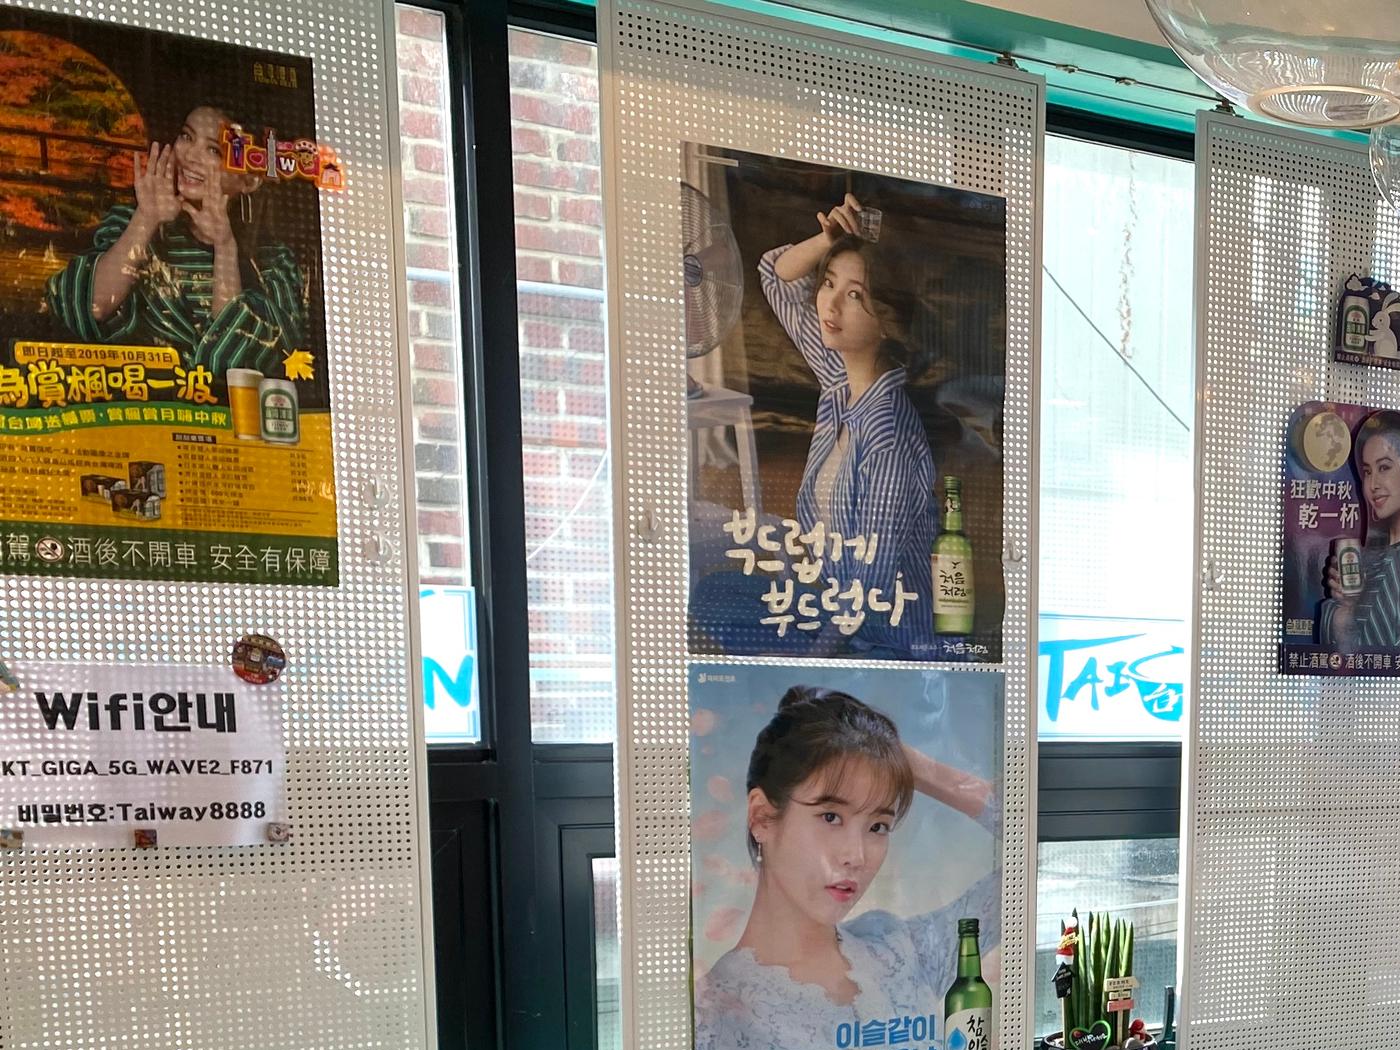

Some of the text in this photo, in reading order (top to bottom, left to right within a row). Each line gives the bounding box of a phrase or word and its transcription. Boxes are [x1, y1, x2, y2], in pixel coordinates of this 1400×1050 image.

[1291, 479, 1353, 501] 狂歡中秋
[1298, 502, 1360, 529] 乾一杯
[67, 536, 197, 568] 酒後不開車
[210, 543, 331, 573] 安全有保障
[760, 571, 918, 637] 부드럽다
[1289, 652, 1329, 668] 禁止酒駕
[1345, 653, 1392, 669] 酒後不開車
[35, 692, 237, 733] Wifi안내
[18, 801, 266, 824] 비밀번호:Taiway8888
[836, 1014, 936, 1049] 이슬같이
